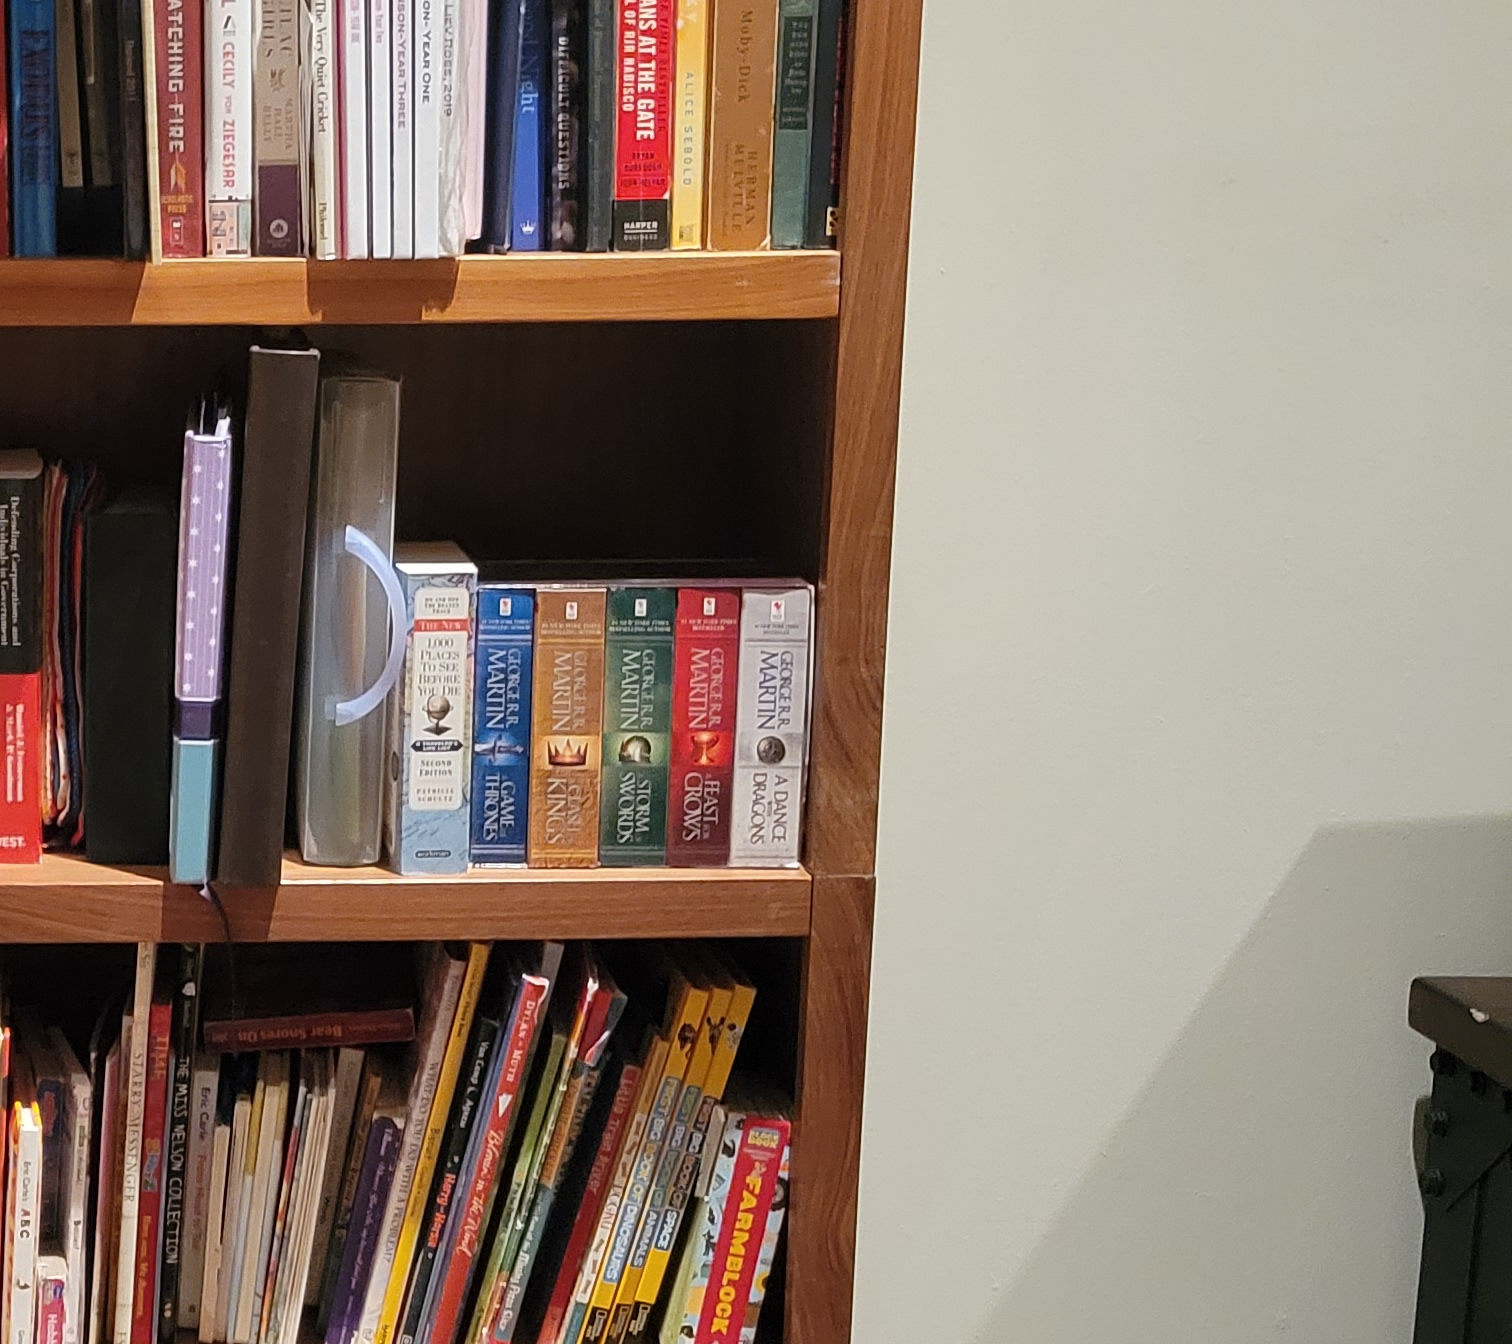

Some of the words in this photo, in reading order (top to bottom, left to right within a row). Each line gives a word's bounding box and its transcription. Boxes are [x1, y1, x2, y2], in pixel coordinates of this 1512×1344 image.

[315, 0, 327, 23] The
[623, 11, 636, 27] OF
[313, 25, 327, 53] Very
[421, 30, 433, 68] YEAR
[622, 31, 636, 54] RJR
[638, 34, 656, 59] AT
[736, 10, 754, 104] Moby-Dick
[222, 42, 235, 89] CECILY
[314, 56, 327, 89] Quiet
[421, 72, 433, 104] ONE
[621, 57, 635, 113] NABISCO
[636, 62, 655, 94] THE
[168, 104, 184, 153] FIRE
[316, 92, 328, 133] Cricket
[635, 98, 656, 141] GATE
[222, 120, 235, 188] ZIEGESAR
[485, 648, 507, 729] MARTIN
[551, 651, 573, 732] MARTIN
[619, 648, 641, 730] MARTIN
[687, 648, 709, 729] MARTIN
[756, 649, 780, 731] MARTIN
[773, 774, 789, 787] A
[482, 773, 502, 842] THRONES
[544, 778, 567, 845] KINGS
[615, 773, 637, 844] SWORDS
[681, 773, 704, 842] CROWS
[749, 772, 768, 845] DRAGONS
[771, 790, 788, 844] DANCE
[176, 1057, 190, 1081] THE
[174, 1083, 188, 1118] MISS
[170, 1124, 186, 1172] NELSON
[165, 1177, 183, 1264] COLLECTION
[657, 1210, 681, 1250] SPACE
[710, 1176, 762, 1336] FARMBLOCK
